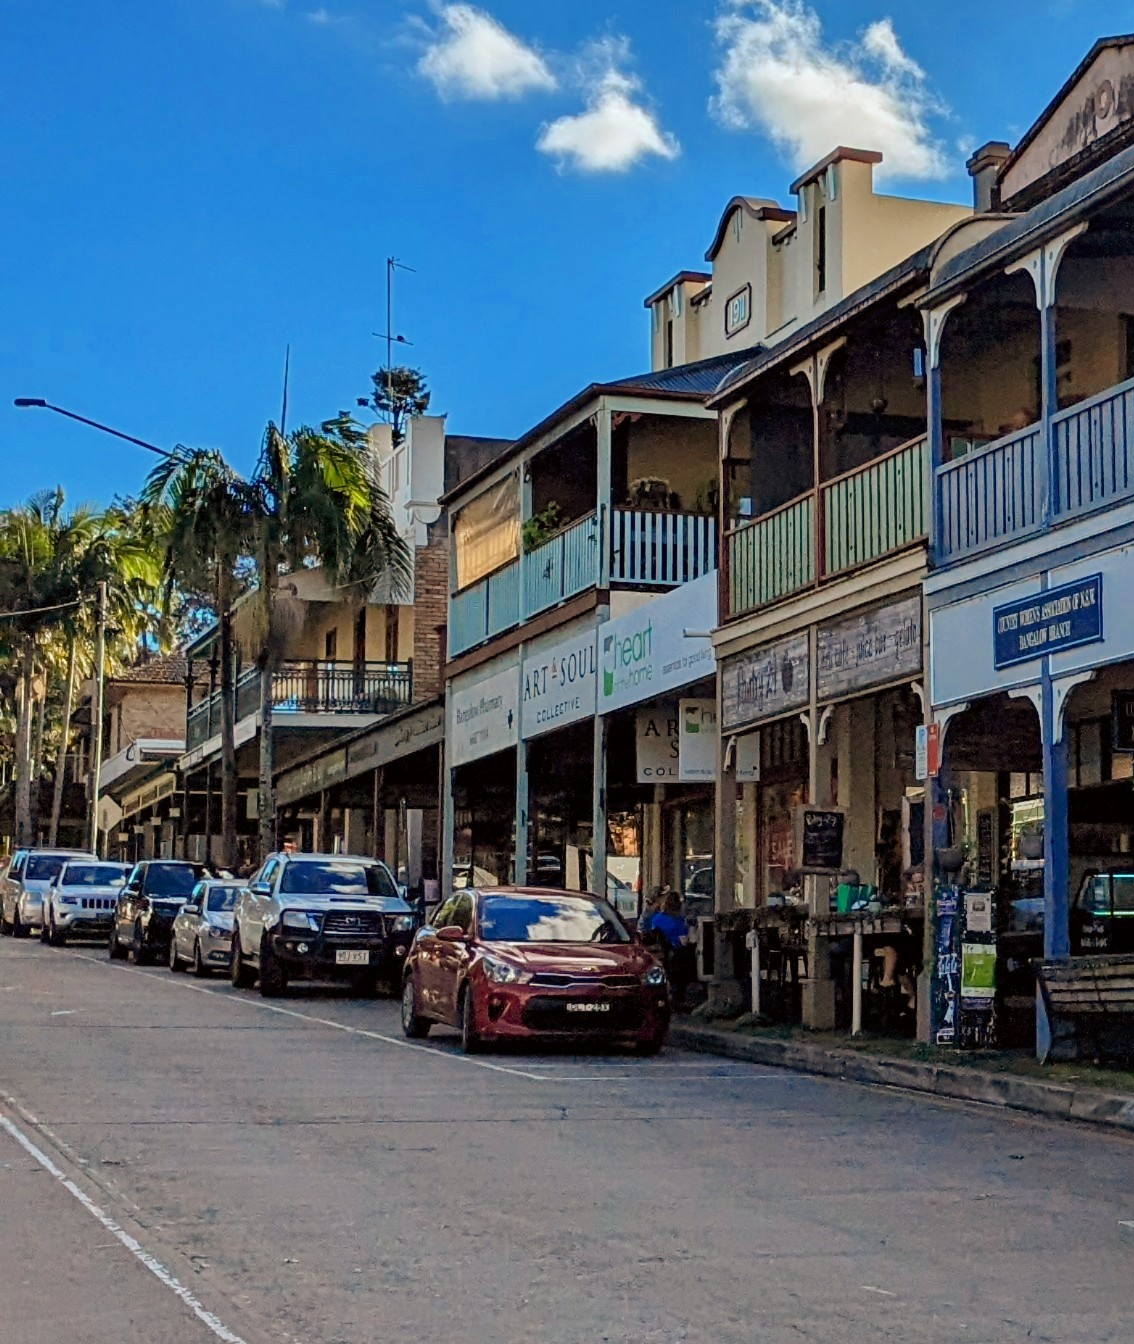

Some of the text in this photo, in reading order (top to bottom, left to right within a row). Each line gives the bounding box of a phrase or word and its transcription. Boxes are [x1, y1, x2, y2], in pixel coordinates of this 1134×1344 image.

[730, 295, 746, 327] 1911
[614, 618, 652, 669] heart
[523, 665, 549, 702] ART
[560, 645, 596, 686] SOUL
[536, 696, 580, 724] COLLECTIVE
[644, 719, 680, 737] AR
